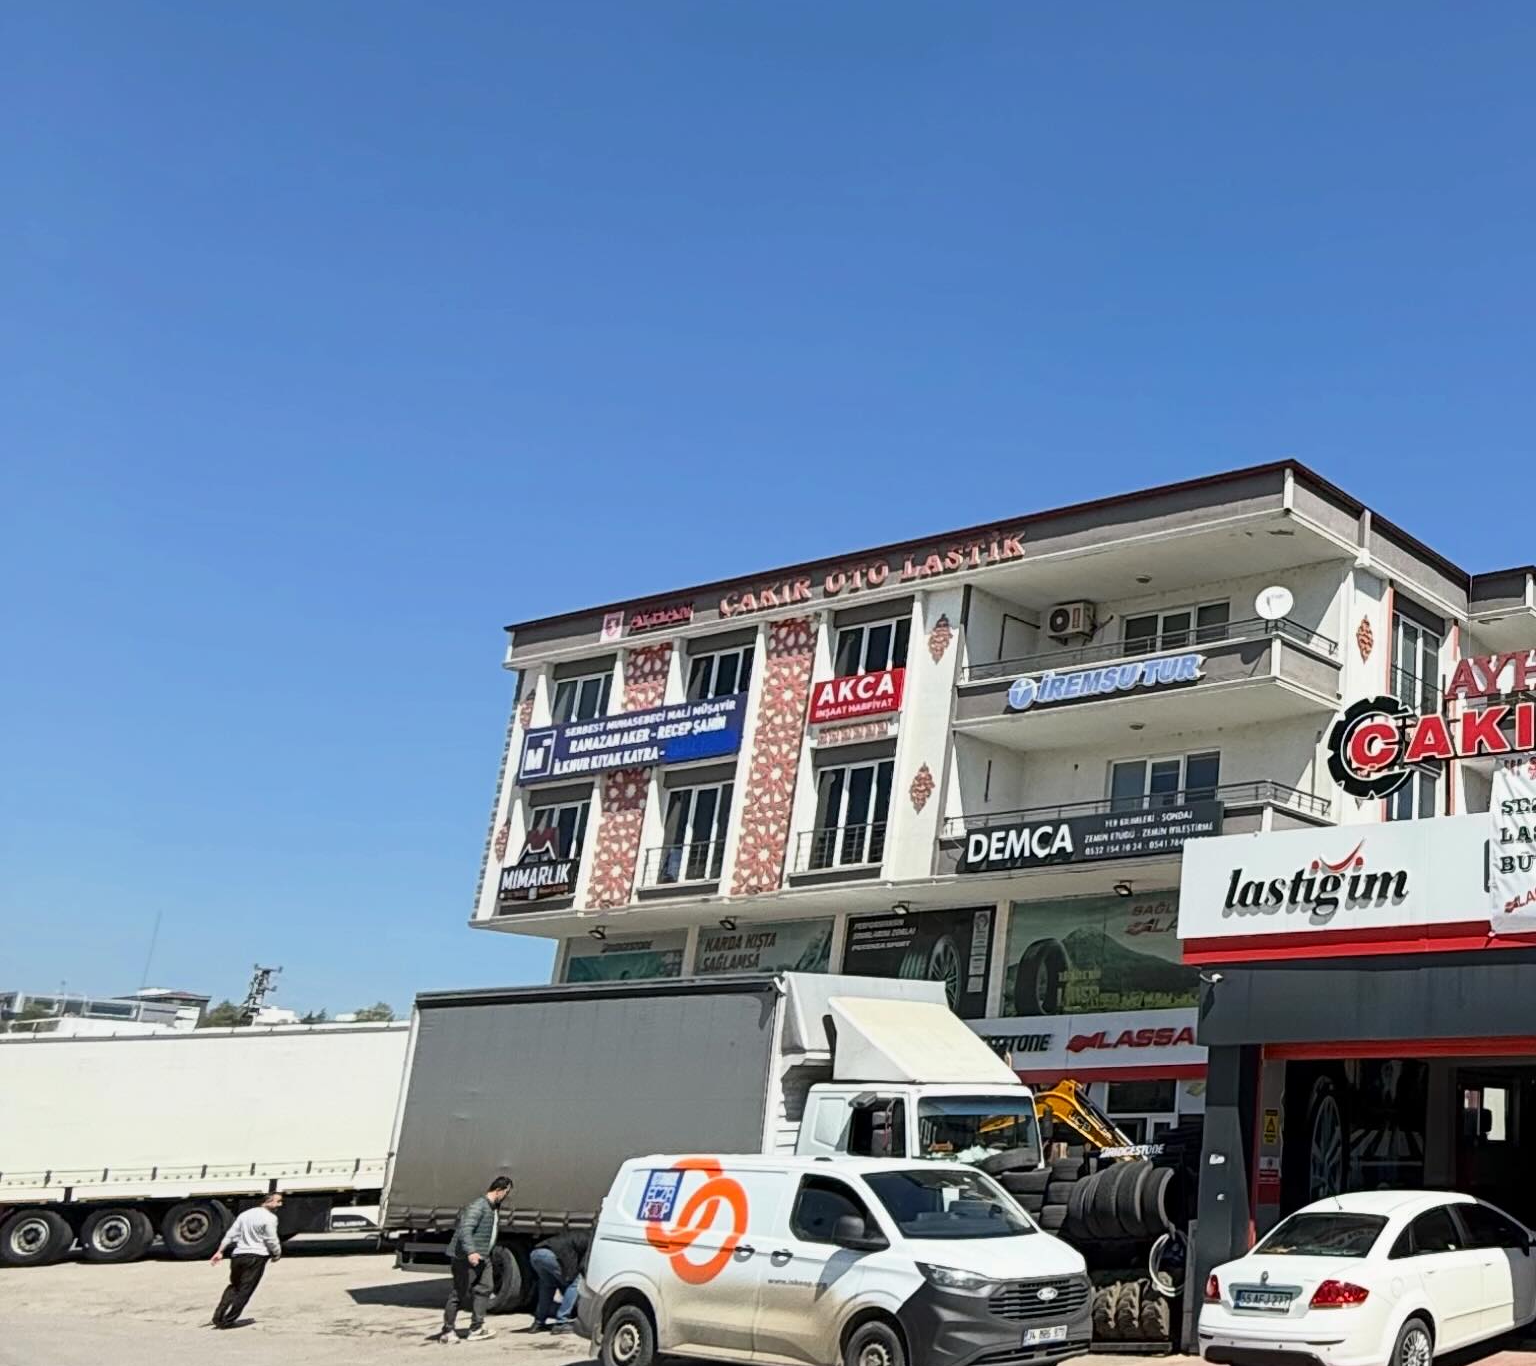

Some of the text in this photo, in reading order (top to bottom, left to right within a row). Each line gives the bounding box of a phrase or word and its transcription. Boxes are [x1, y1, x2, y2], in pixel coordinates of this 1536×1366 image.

[718, 576, 812, 620] ÇAKIR
[824, 560, 890, 595] OTO
[1142, 653, 1202, 686] TUR
[568, 733, 620, 754] RAMAZAN
[1224, 838, 1410, 917] lastiğim
[1132, 901, 1178, 916] SAĞL
[705, 935, 743, 953] KARDA
[1098, 1026, 1194, 1050] LASSA
